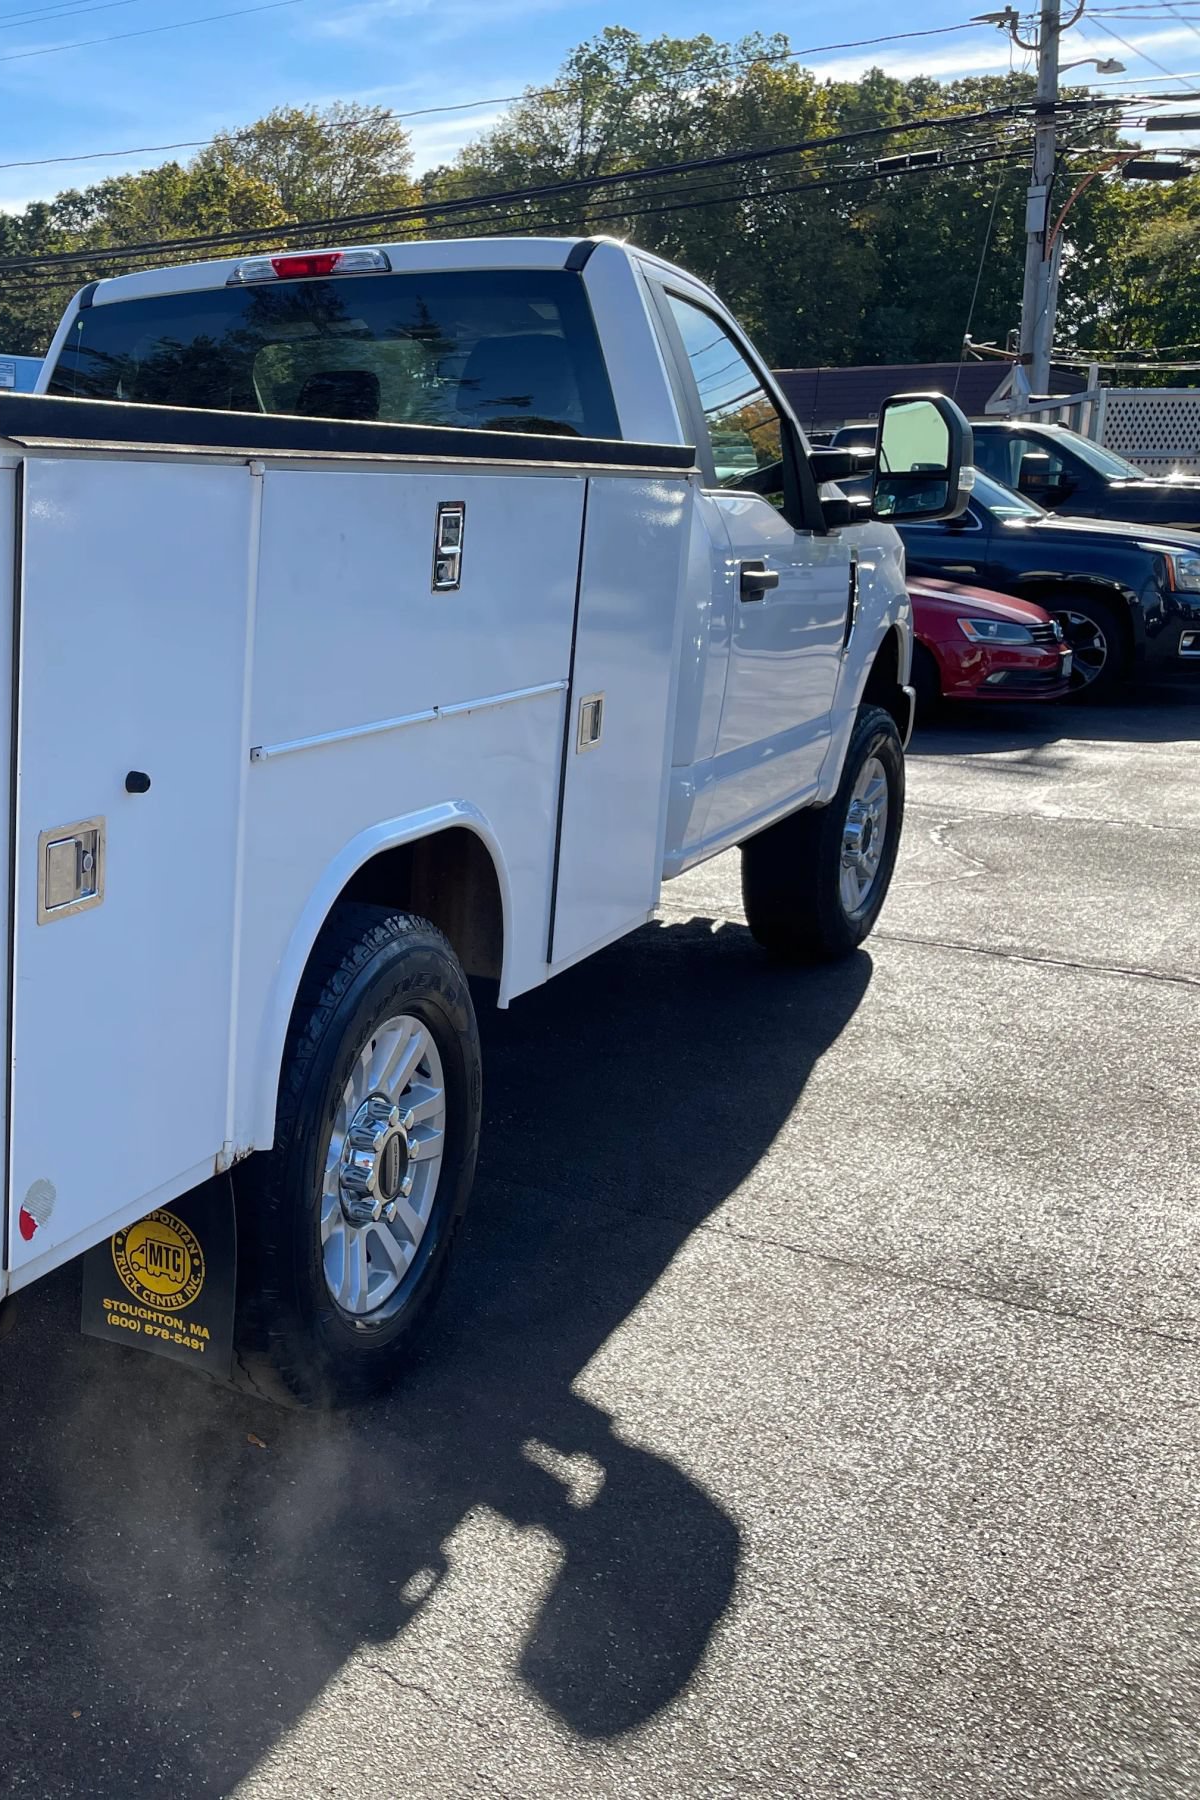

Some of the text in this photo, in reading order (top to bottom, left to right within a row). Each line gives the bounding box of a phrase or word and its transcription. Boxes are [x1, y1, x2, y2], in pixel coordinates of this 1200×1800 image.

[115, 1250, 202, 1307] TRUCK CENTER INC.
[149, 1243, 181, 1273] MTC
[102, 1297, 211, 1340] STOUGHTON, MA
[107, 1312, 206, 1353] (800) 878-5491
